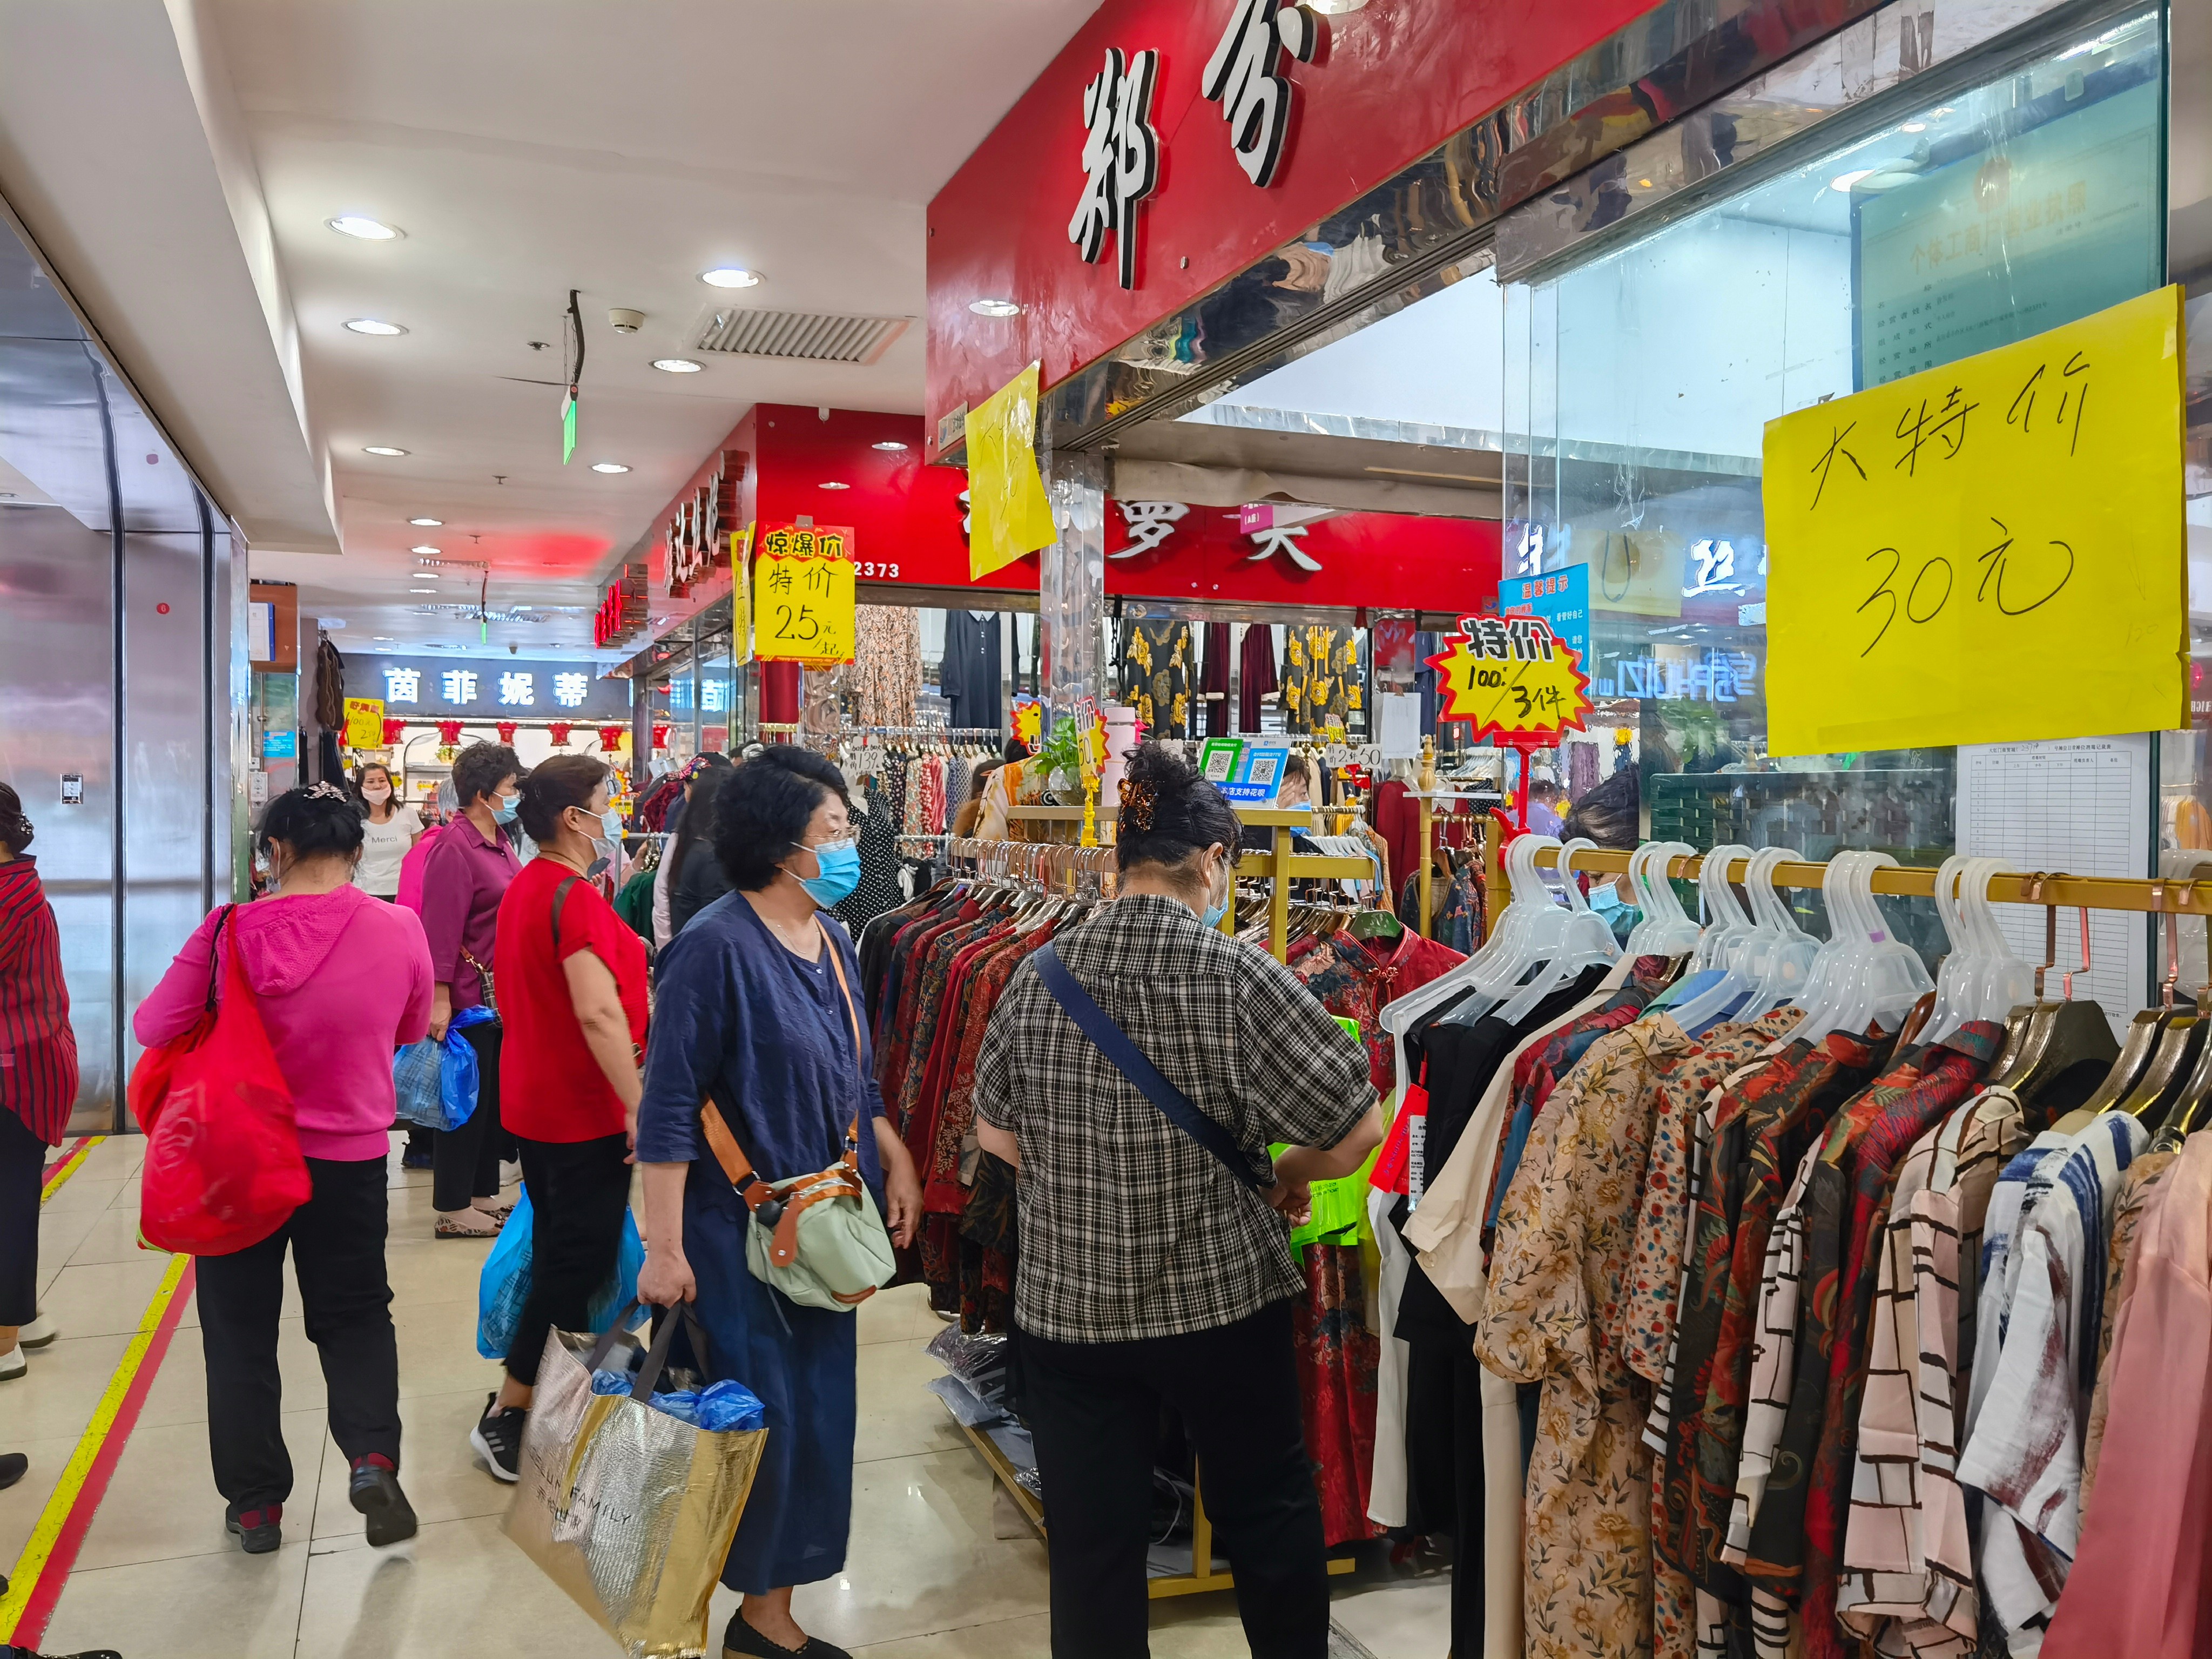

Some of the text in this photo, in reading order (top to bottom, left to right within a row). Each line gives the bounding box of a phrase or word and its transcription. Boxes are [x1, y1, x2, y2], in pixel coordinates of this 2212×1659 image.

[1811, 350, 2090, 511] 大特价
[765, 530, 844, 558] 惊爆价
[768, 563, 839, 598] 特价
[1521, 574, 1569, 599] 温馨提示
[1856, 517, 2074, 658] 30元
[1461, 619, 1555, 662] 特价
[382, 667, 589, 708] 茵菲妮蒂
[570, 1487, 631, 1525] FAMILY
